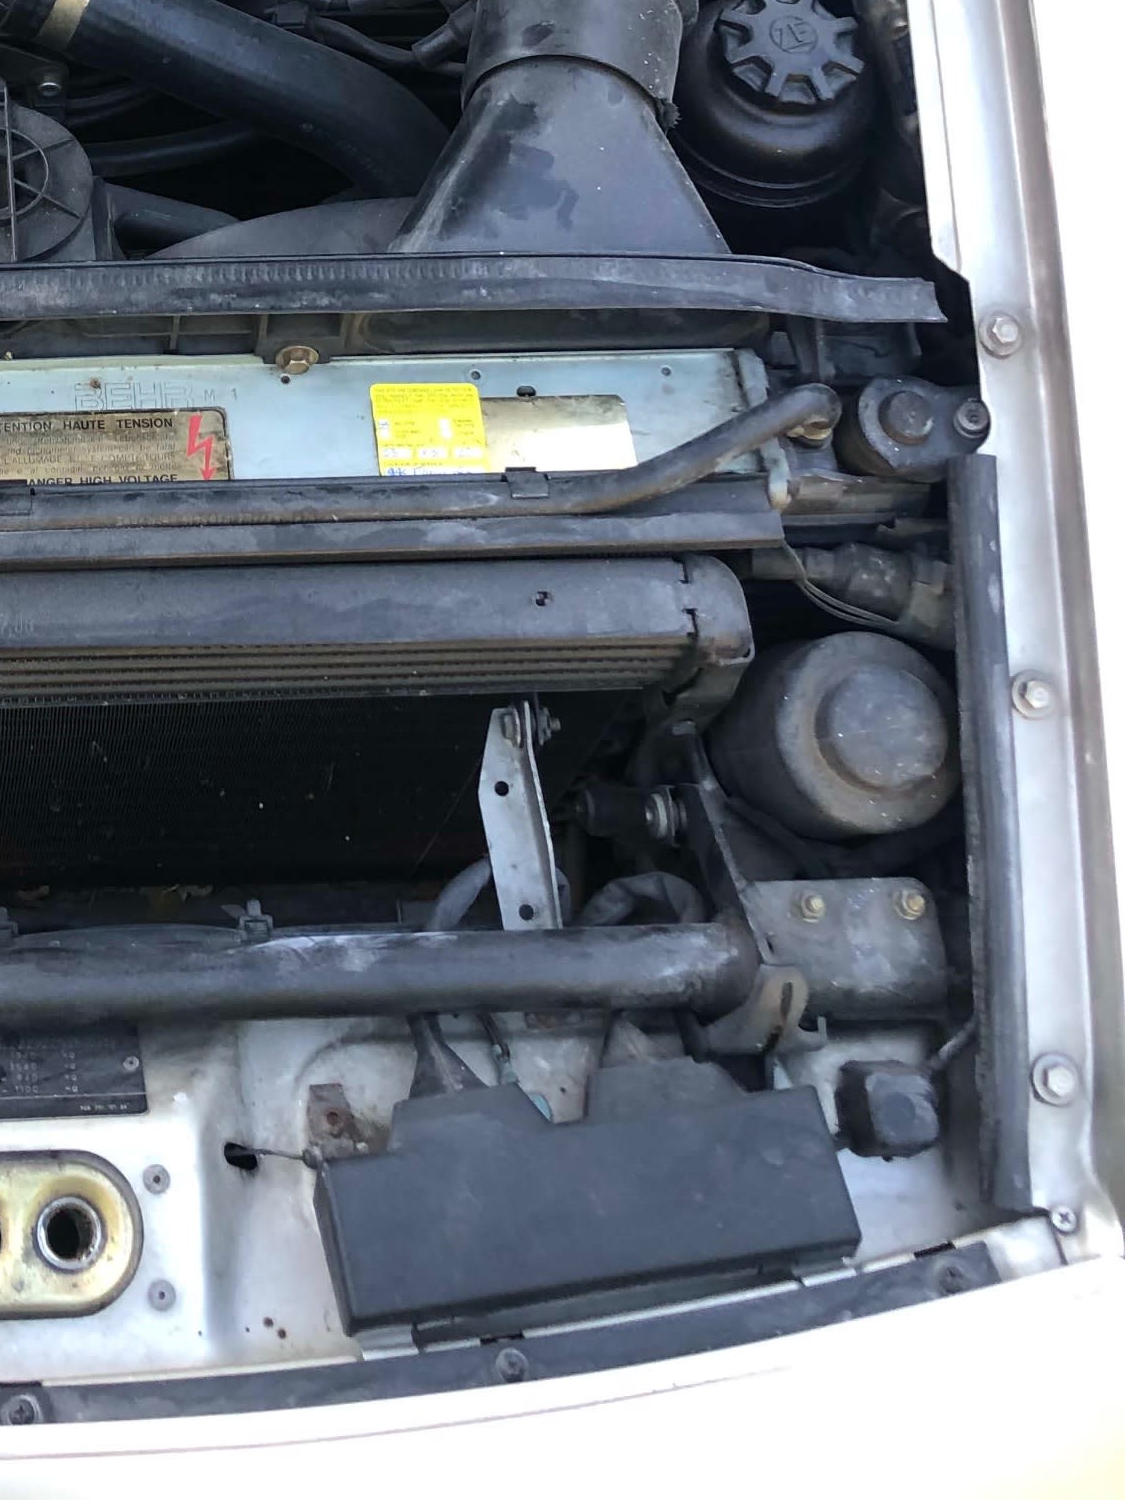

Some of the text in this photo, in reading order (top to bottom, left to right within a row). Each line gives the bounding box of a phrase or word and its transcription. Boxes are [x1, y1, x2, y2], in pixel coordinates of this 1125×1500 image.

[75, 382, 194, 411] BEHR
[63, 419, 105, 431] HAUTE
[116, 417, 173, 430] TENSION
[27, 477, 74, 486] ANGER
[79, 475, 112, 485] HIGH
[118, 473, 179, 484] VOLTAGE
